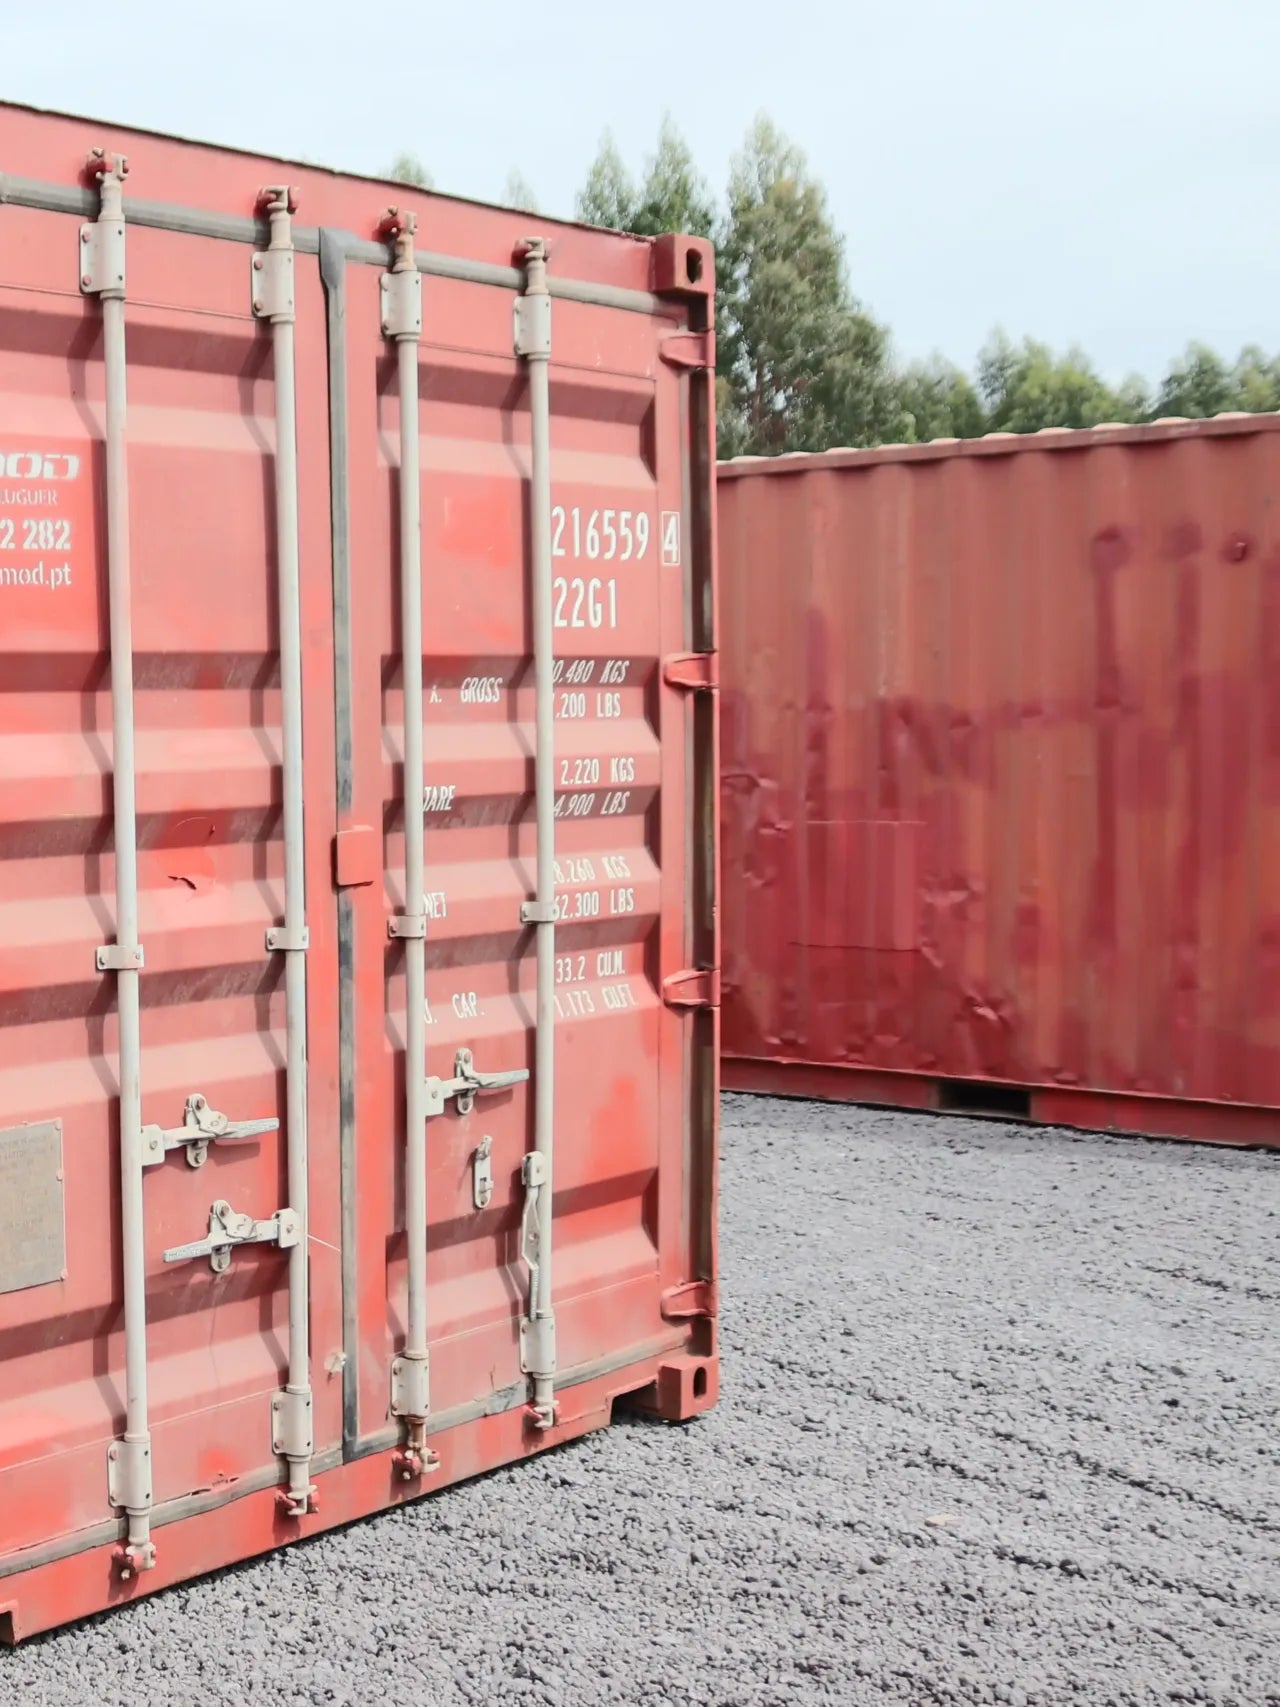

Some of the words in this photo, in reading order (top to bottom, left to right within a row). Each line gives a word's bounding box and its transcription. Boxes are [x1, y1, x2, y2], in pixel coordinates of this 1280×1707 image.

[22, 519, 71, 550] 282
[552, 505, 649, 560] 216559
[663, 514, 679, 563] 4
[554, 576, 616, 628] 22G1
[552, 659, 595, 684] 0.480
[599, 660, 629, 684] KGS
[460, 676, 503, 703] GROSS
[552, 692, 586, 718] .200
[596, 693, 621, 718] LBS
[560, 757, 600, 786] 2.220
[610, 757, 635, 783] KGS
[423, 785, 456, 812] TARE
[553, 794, 595, 817] 4.900
[600, 791, 631, 815] LBS
[553, 860, 596, 885] 8.260
[602, 856, 631, 880] KGS
[423, 891, 447, 918] NET
[609, 888, 634, 915] LBS
[556, 955, 586, 984] 33.2
